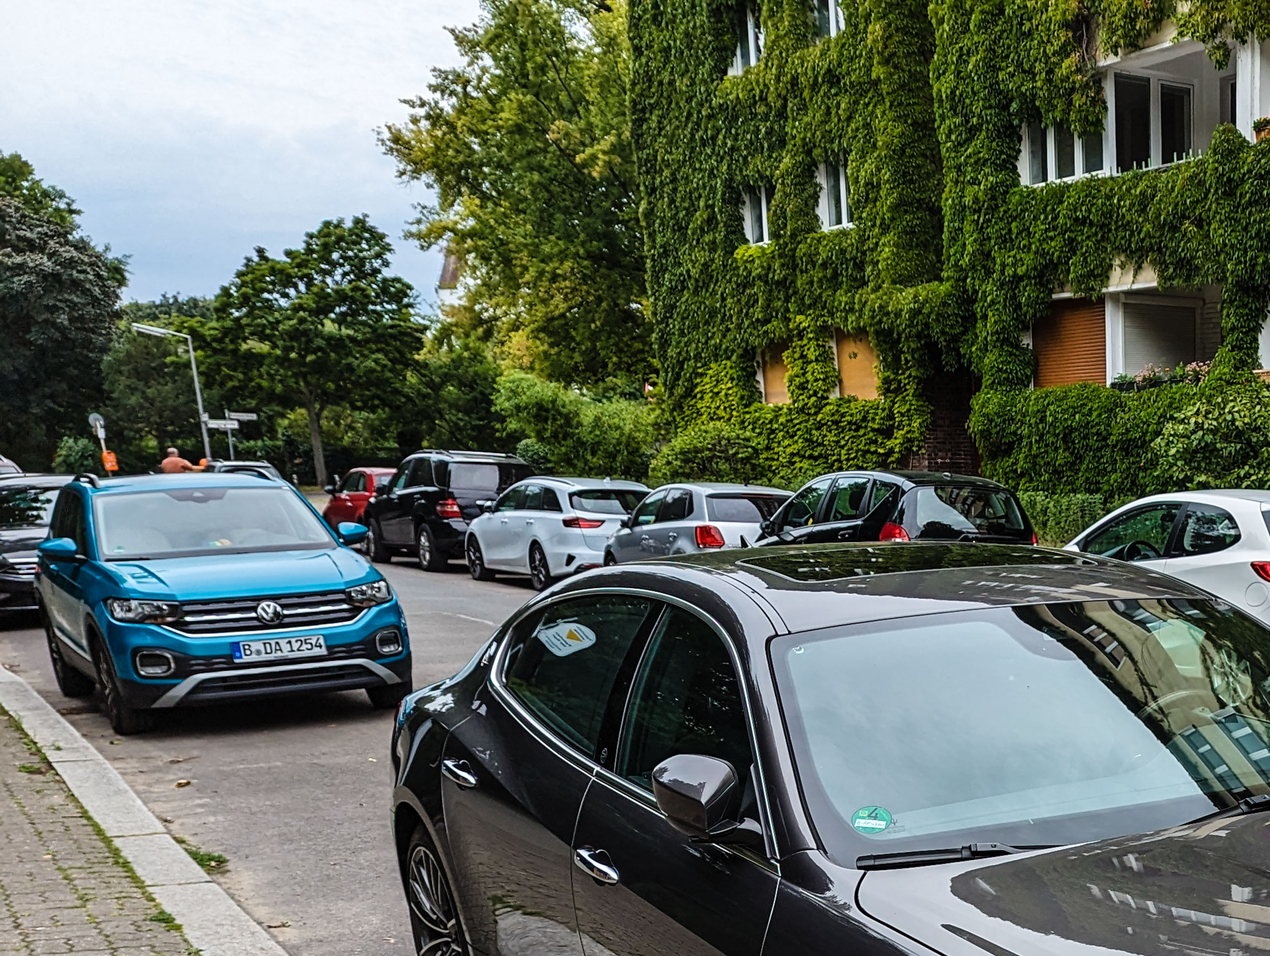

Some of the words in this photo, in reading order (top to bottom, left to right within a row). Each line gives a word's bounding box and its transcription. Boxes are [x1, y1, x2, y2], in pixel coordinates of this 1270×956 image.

[242, 643, 253, 657] B
[262, 641, 284, 655] DA
[285, 637, 323, 653] 1254
